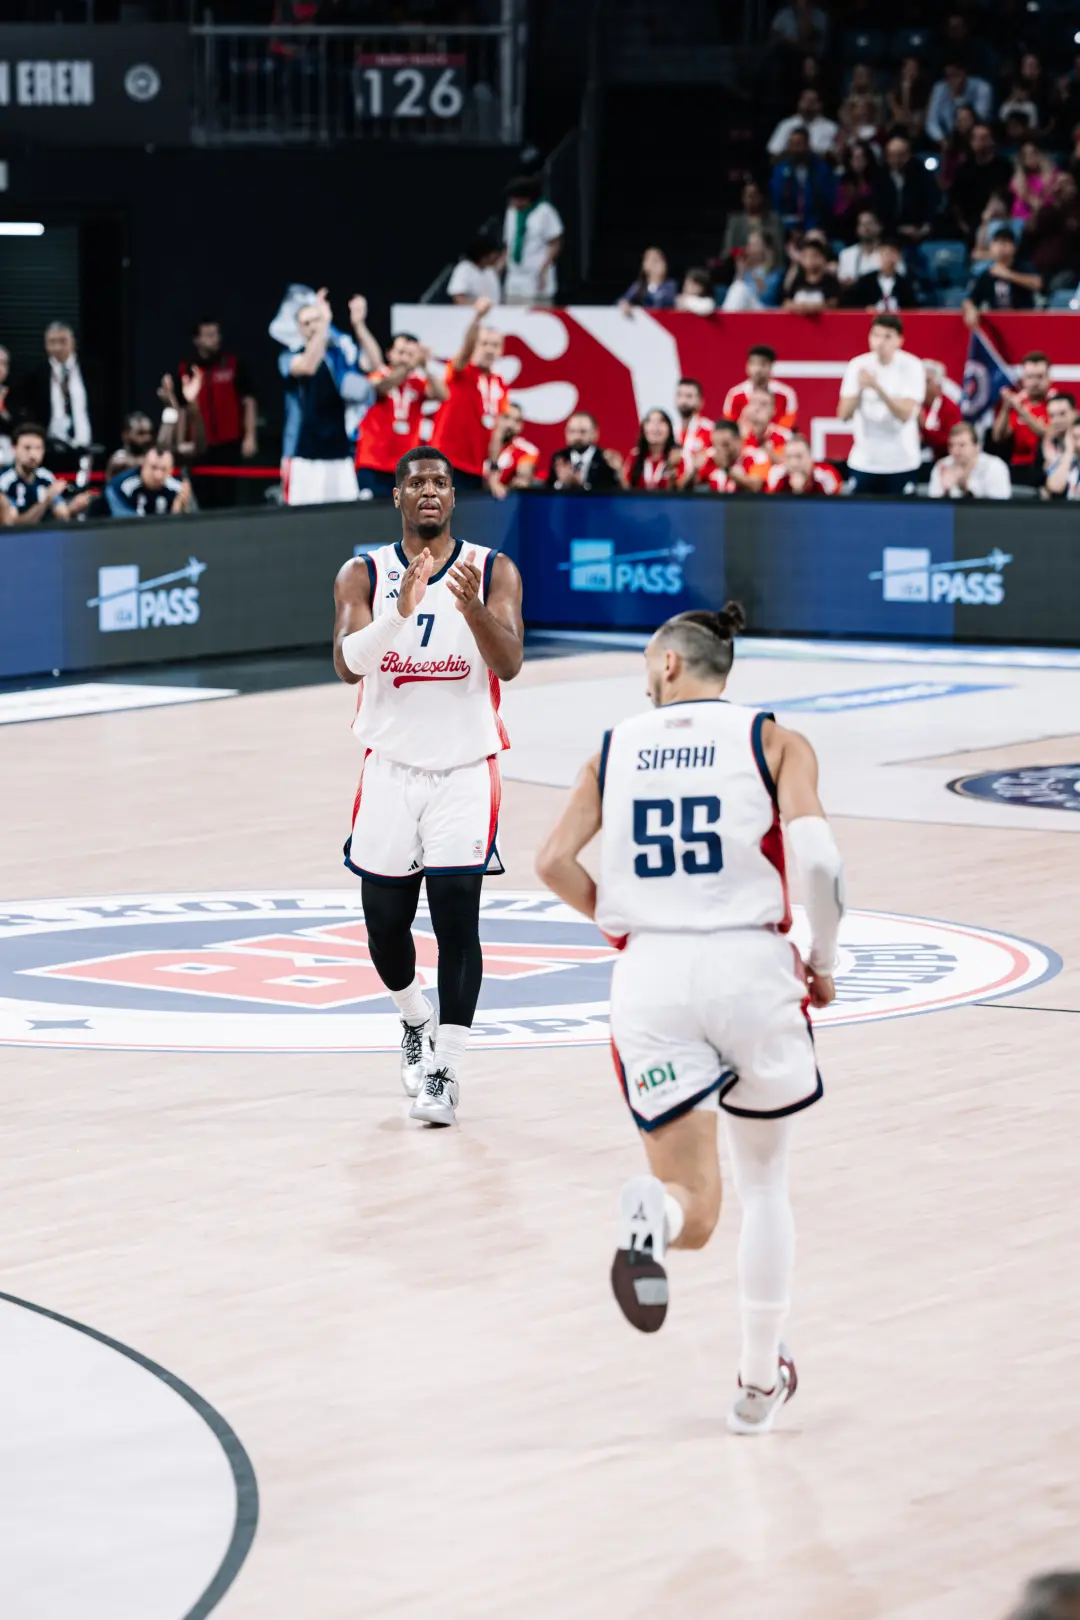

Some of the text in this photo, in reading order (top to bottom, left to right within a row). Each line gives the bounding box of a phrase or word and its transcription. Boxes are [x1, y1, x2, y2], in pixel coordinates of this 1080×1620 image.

[15, 60, 94, 106] EREN
[362, 68, 464, 119] 126
[616, 563, 683, 596] PASS
[931, 571, 1005, 605] PASS
[139, 586, 200, 629] PASS
[416, 613, 435, 648] 7
[637, 740, 716, 771] SİPAHİ
[632, 796, 724, 879] 55
[634, 1061, 677, 1097] HDI
